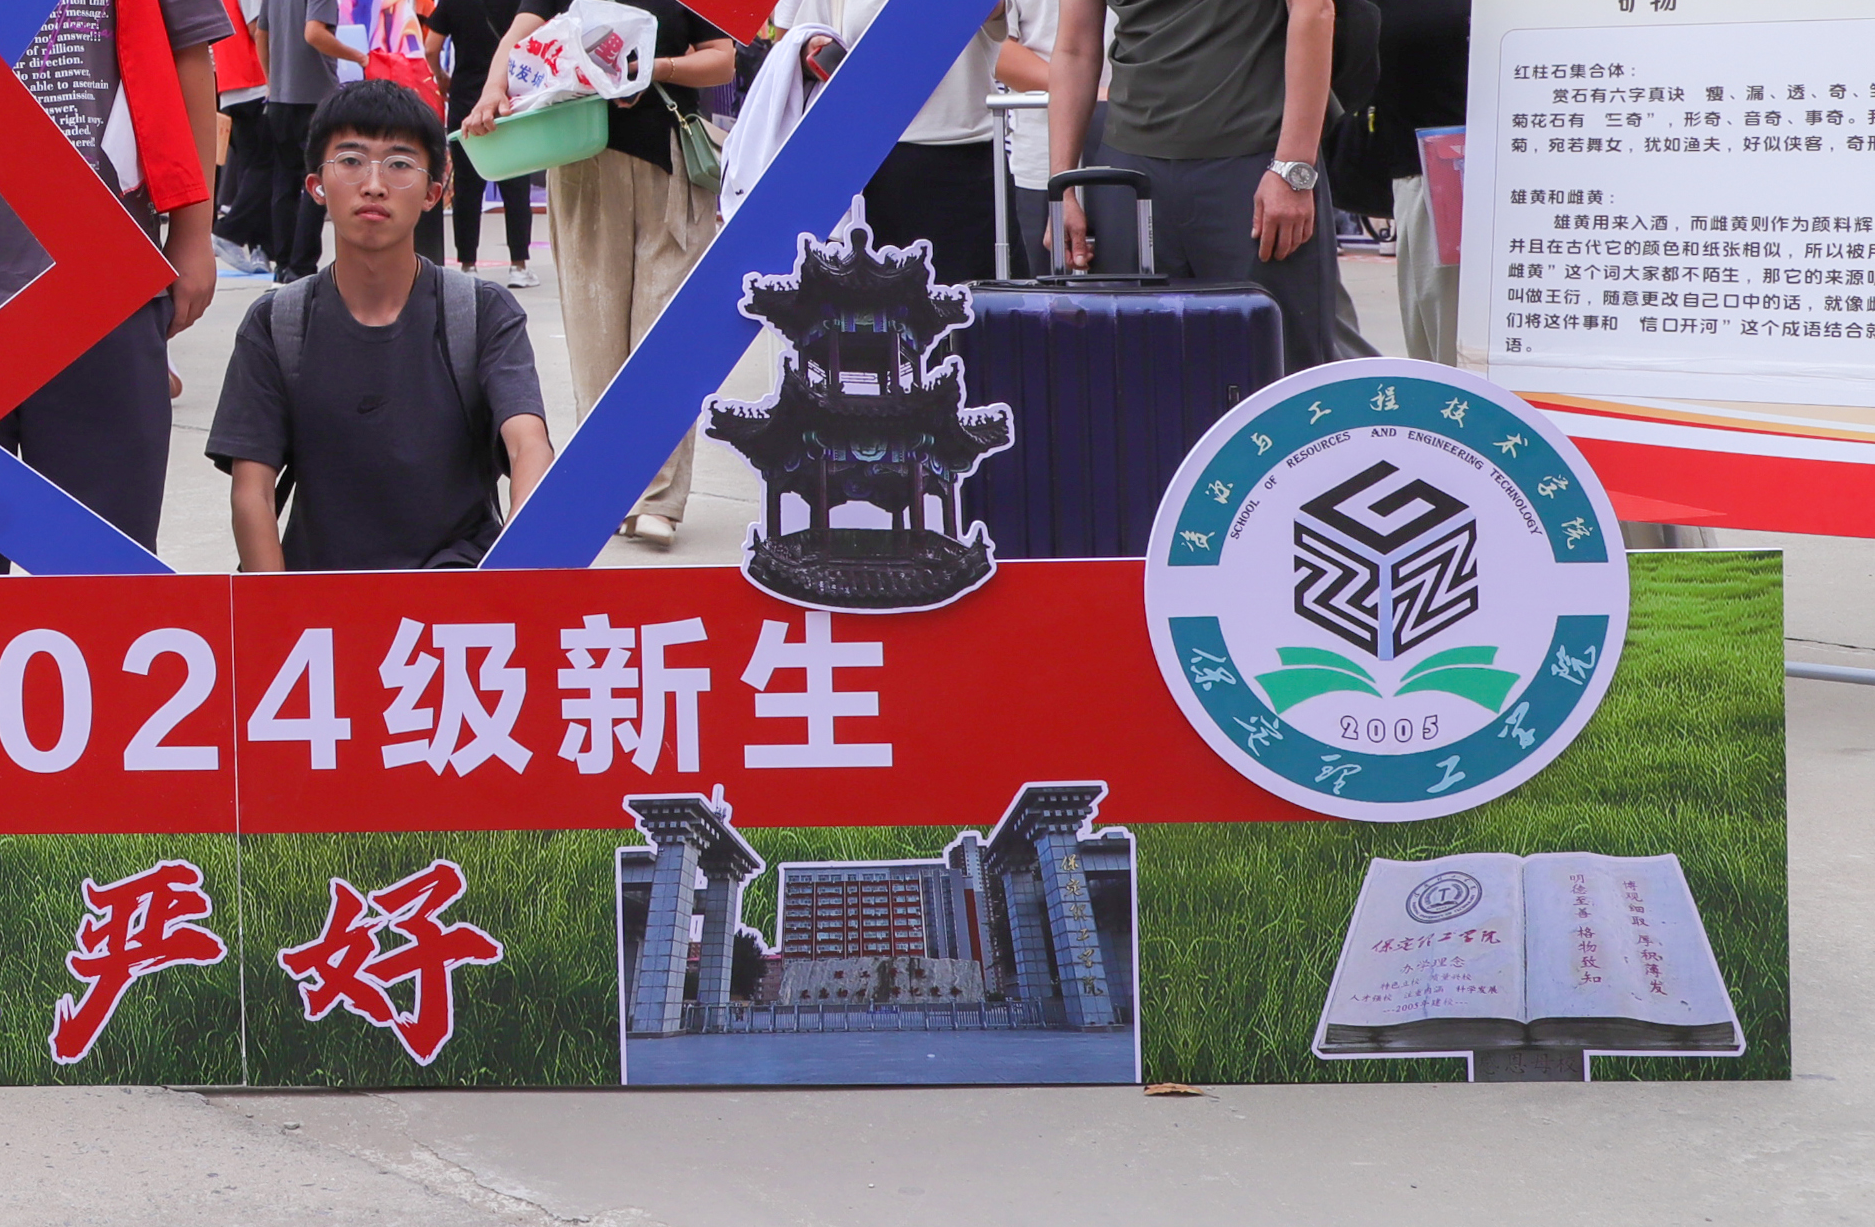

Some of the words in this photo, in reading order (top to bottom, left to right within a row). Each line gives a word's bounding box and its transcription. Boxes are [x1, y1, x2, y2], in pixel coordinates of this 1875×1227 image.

[26, 46, 40, 56] of
[32, 70, 51, 80] not
[29, 81, 54, 92] able
[57, 81, 69, 90] to
[59, 113, 85, 127] right
[1510, 189, 1615, 206] 雄黄和雌黄：
[1505, 337, 1532, 353] 语。
[1230, 499, 1260, 540] SCHOOL
[1264, 474, 1277, 490] OF
[1286, 431, 1351, 468] RESOURCES
[1371, 428, 1397, 438] AND
[1407, 430, 1484, 470] ENGINEERING
[1490, 467, 1543, 536] TECHNOLOGY
[1339, 715, 1440, 742] 2005
[1569, 874, 1592, 919] 明德至善
[1371, 929, 1501, 953] 保定理工学院
[1623, 880, 1650, 927] 博观细取
[1637, 934, 1668, 996] 厚积薄发
[1577, 925, 1602, 986] 格物致知
[1400, 956, 1465, 974] 办学理念
[1456, 985, 1498, 995] 科学发展
